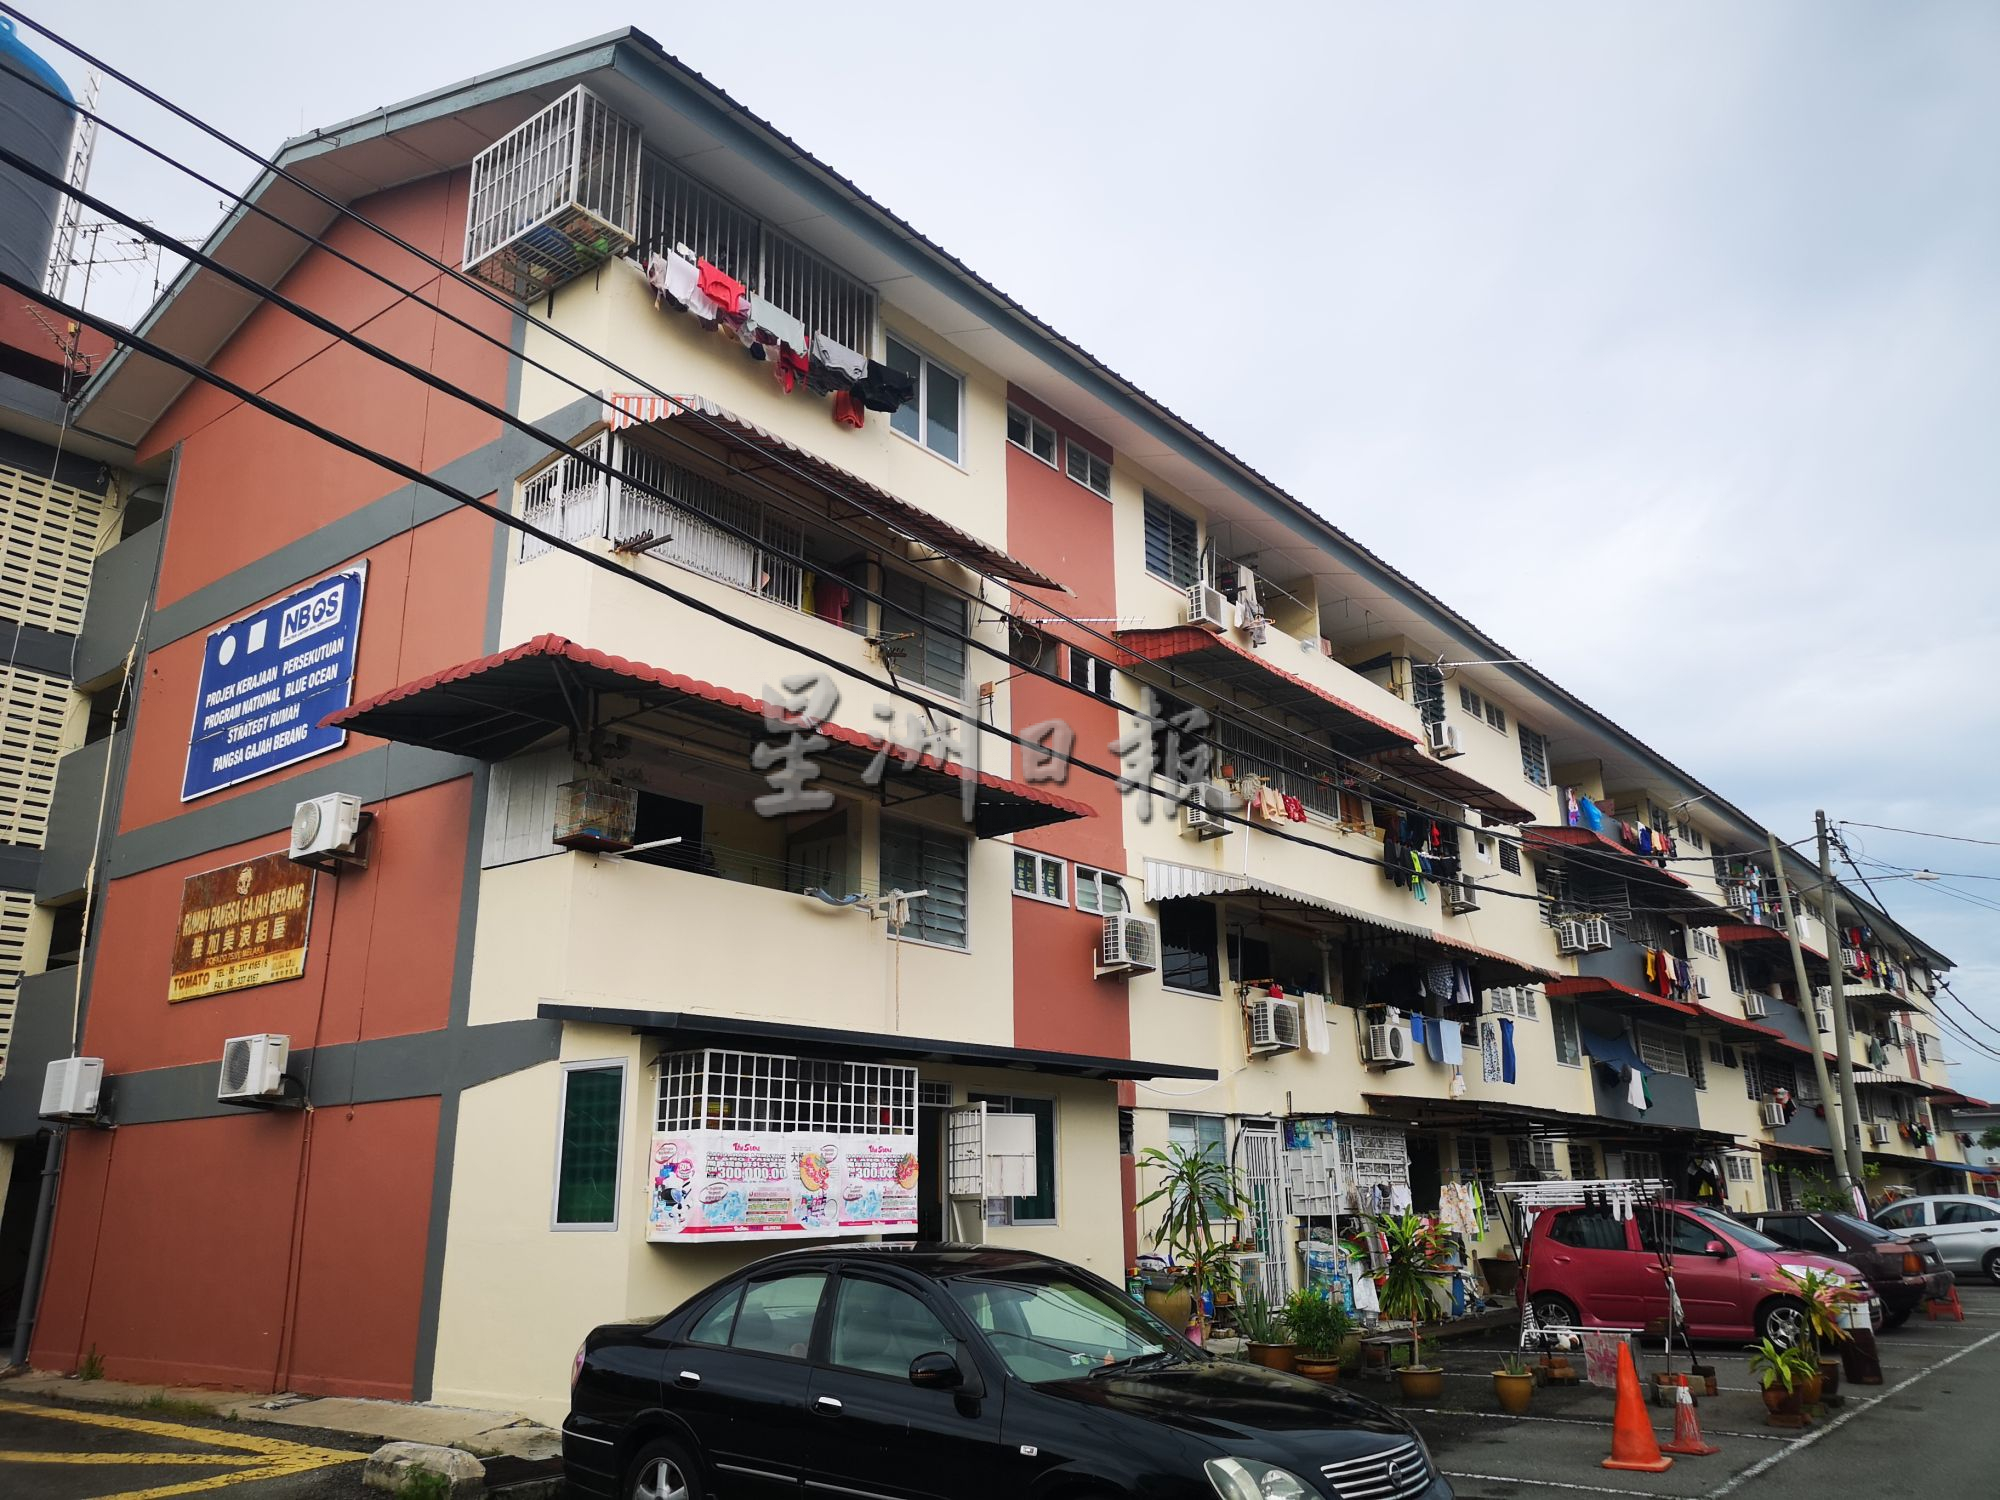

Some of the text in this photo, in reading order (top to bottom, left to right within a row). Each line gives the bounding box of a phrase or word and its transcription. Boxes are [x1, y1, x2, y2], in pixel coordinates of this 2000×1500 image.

[203, 663, 338, 730] PROGRAM NATIONAL BLUE OCEAN
[206, 636, 344, 708] PROJEK KERAJAAN PERSEKUTUAN
[212, 723, 308, 772] PANGSA GAJAH BERANG
[227, 703, 300, 744] STRATEGY RUMAH
[183, 883, 305, 936] RUMAH PANGSA GAJAH BERANG
[173, 972, 211, 991] TOMATO
